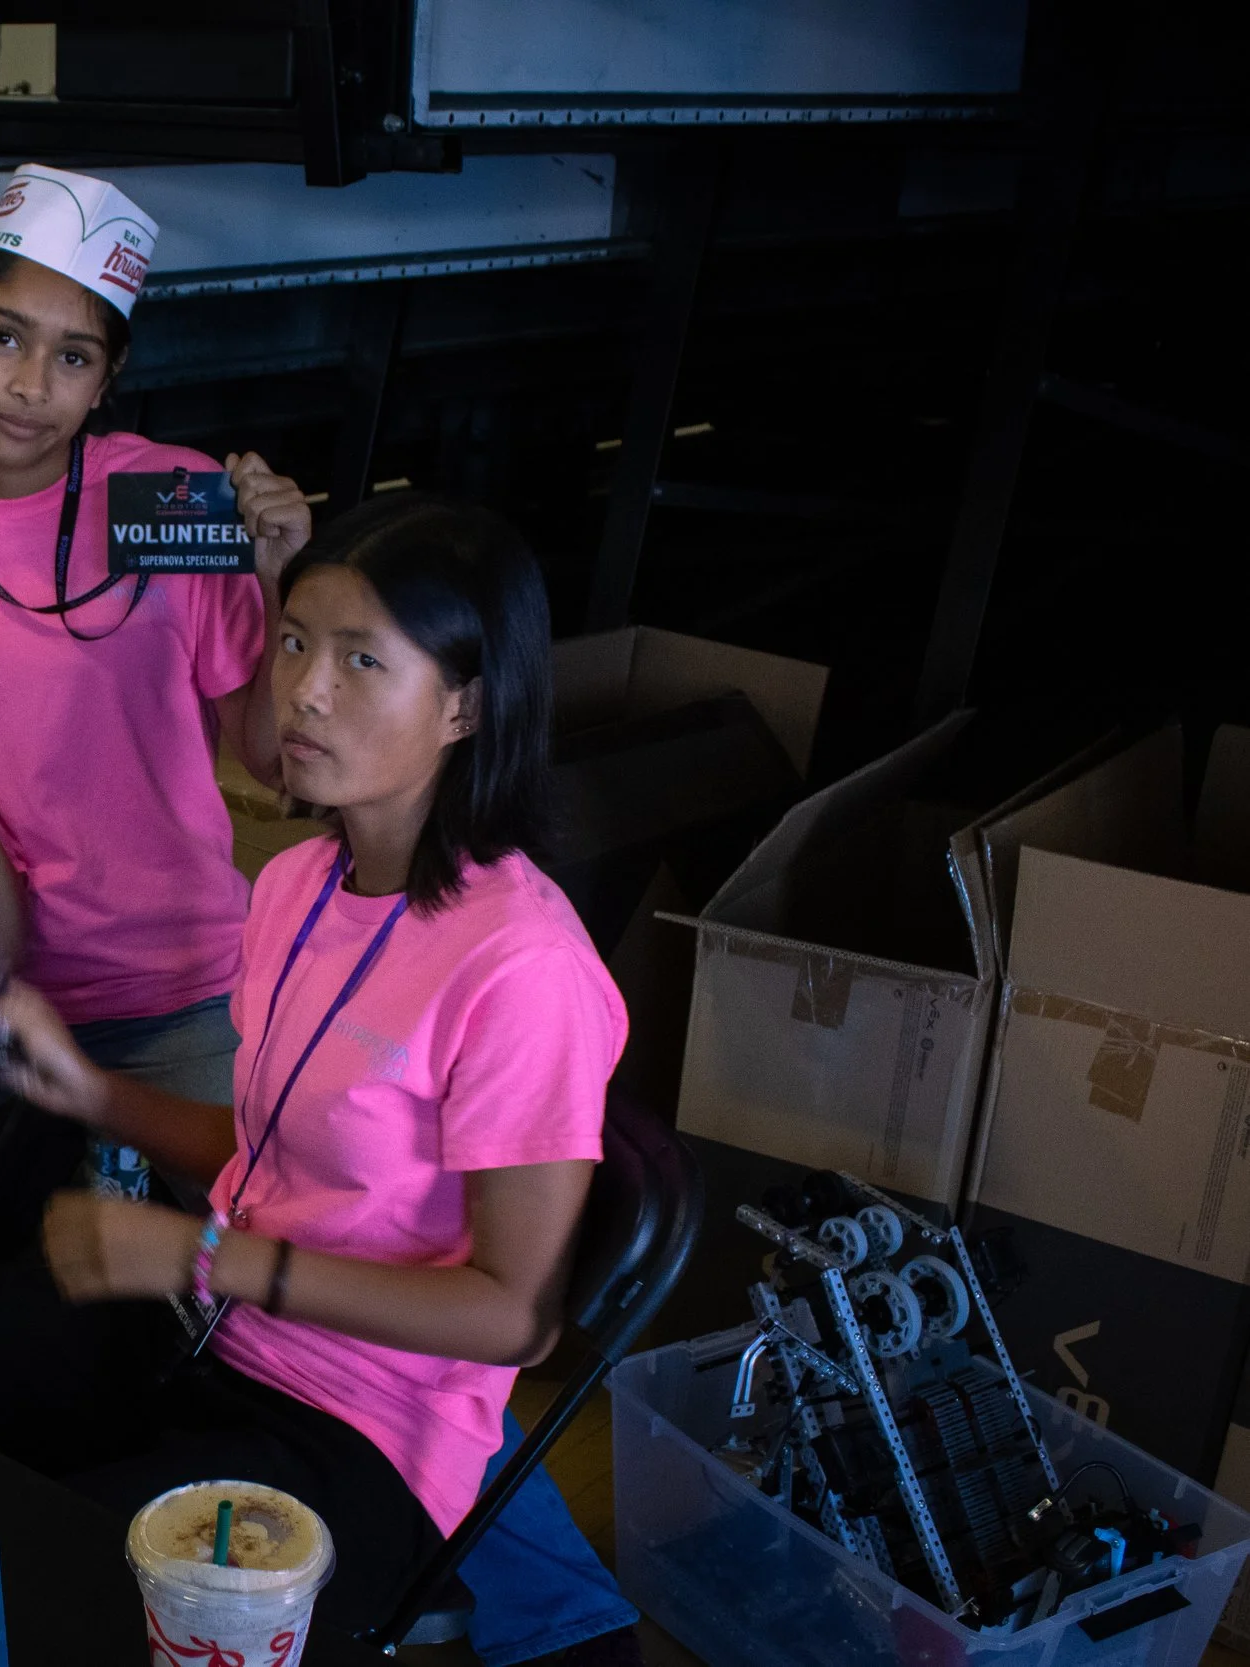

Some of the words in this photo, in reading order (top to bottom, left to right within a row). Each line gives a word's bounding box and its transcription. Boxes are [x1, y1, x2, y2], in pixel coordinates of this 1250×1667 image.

[124, 229, 141, 247] EAT
[155, 484, 207, 504] VEX
[113, 524, 250, 544] VOLUNTEER
[139, 554, 184, 566] SUPERNOVA
[186, 554, 239, 566] SPECTACULAR
[925, 998, 940, 1030] VEX
